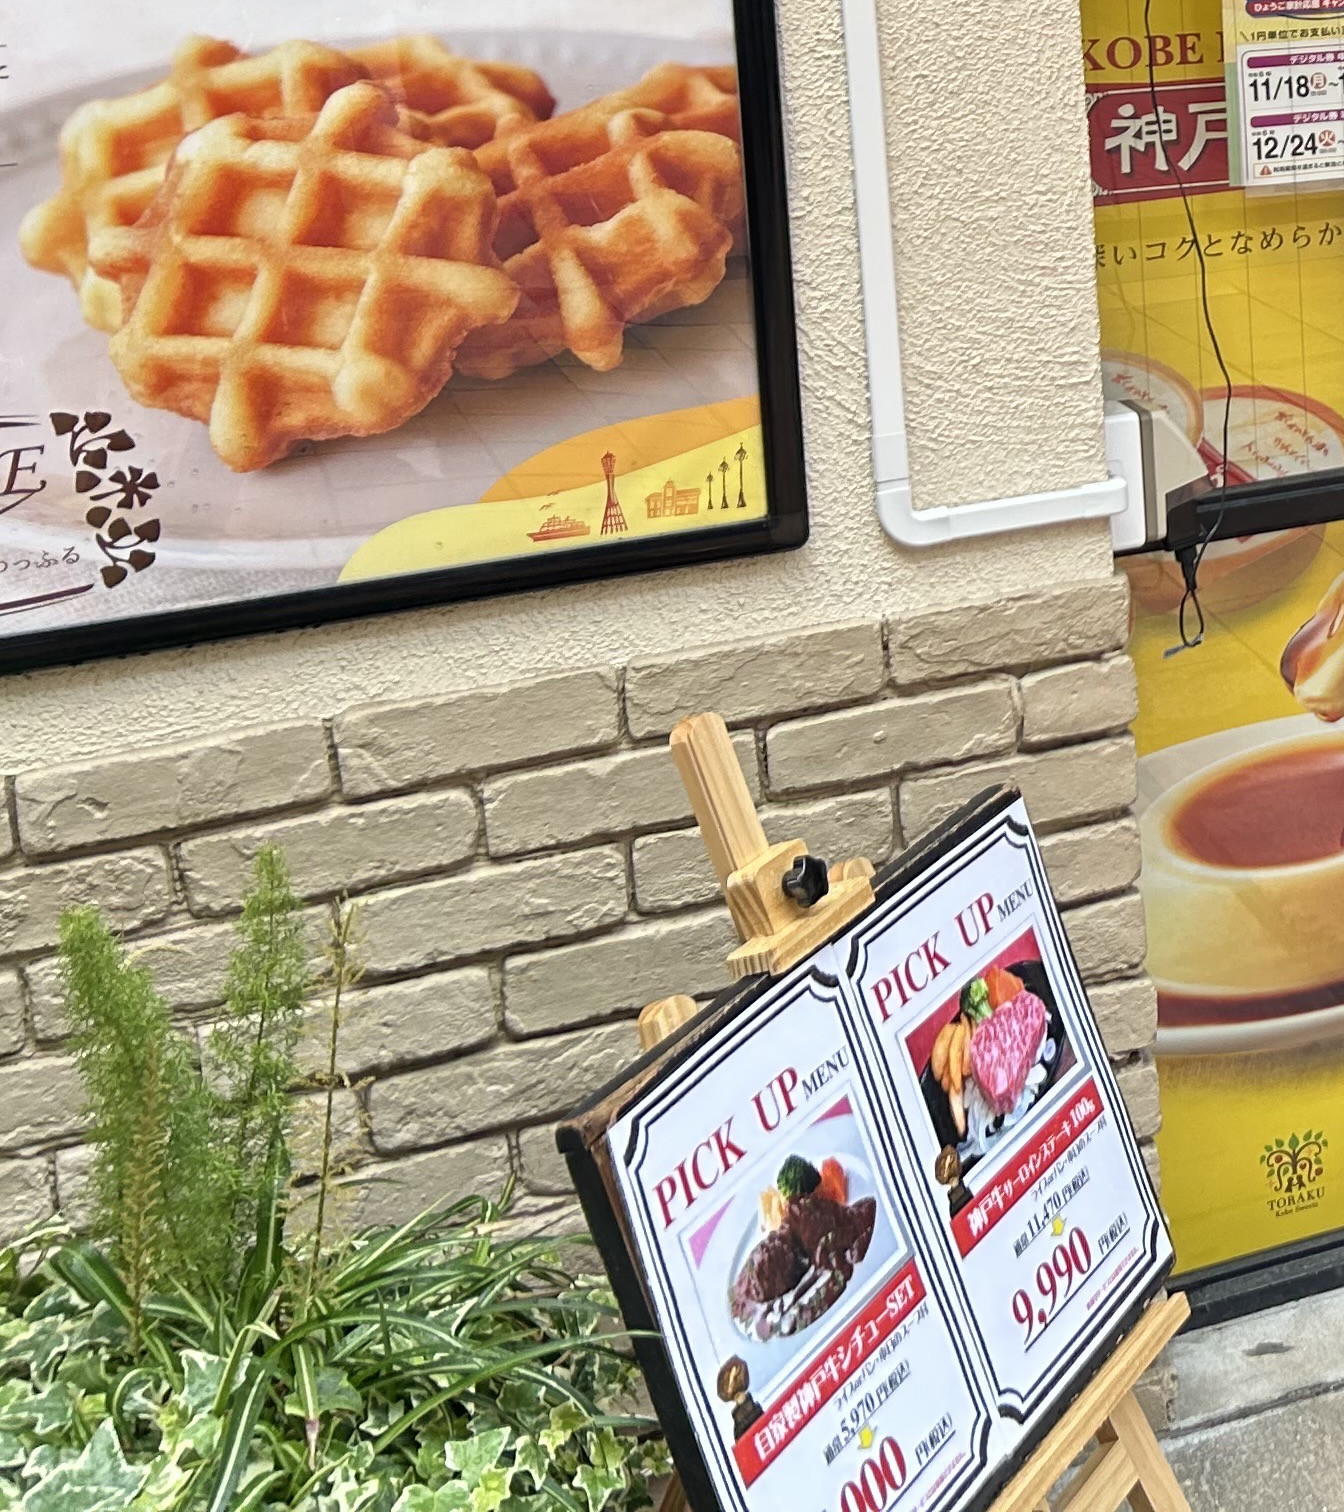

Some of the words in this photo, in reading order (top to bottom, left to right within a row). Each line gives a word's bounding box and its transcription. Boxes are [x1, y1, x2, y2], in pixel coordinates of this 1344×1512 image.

[1081, 33, 1203, 73] KOBE
[1249, 75, 1310, 102] 11/18
[1104, 98, 1227, 176] 神戸
[1252, 132, 1318, 161] 12/24
[870, 930, 951, 1023] PICK
[954, 892, 994, 948] UP
[997, 877, 1034, 922] MENU
[653, 1114, 747, 1230] PICK
[751, 1066, 798, 1133] UP
[801, 1045, 850, 1102] MENU
[967, 1117, 1071, 1239] 神戸牛サーロインステーキ
[1069, 1096, 1096, 1129] 100g
[1026, 1188, 1062, 1237] 11,470
[1266, 1186, 1325, 1211] TORAKU
[1012, 1226, 1091, 1346] 9,990
[840, 1391, 875, 1436] 5,970
